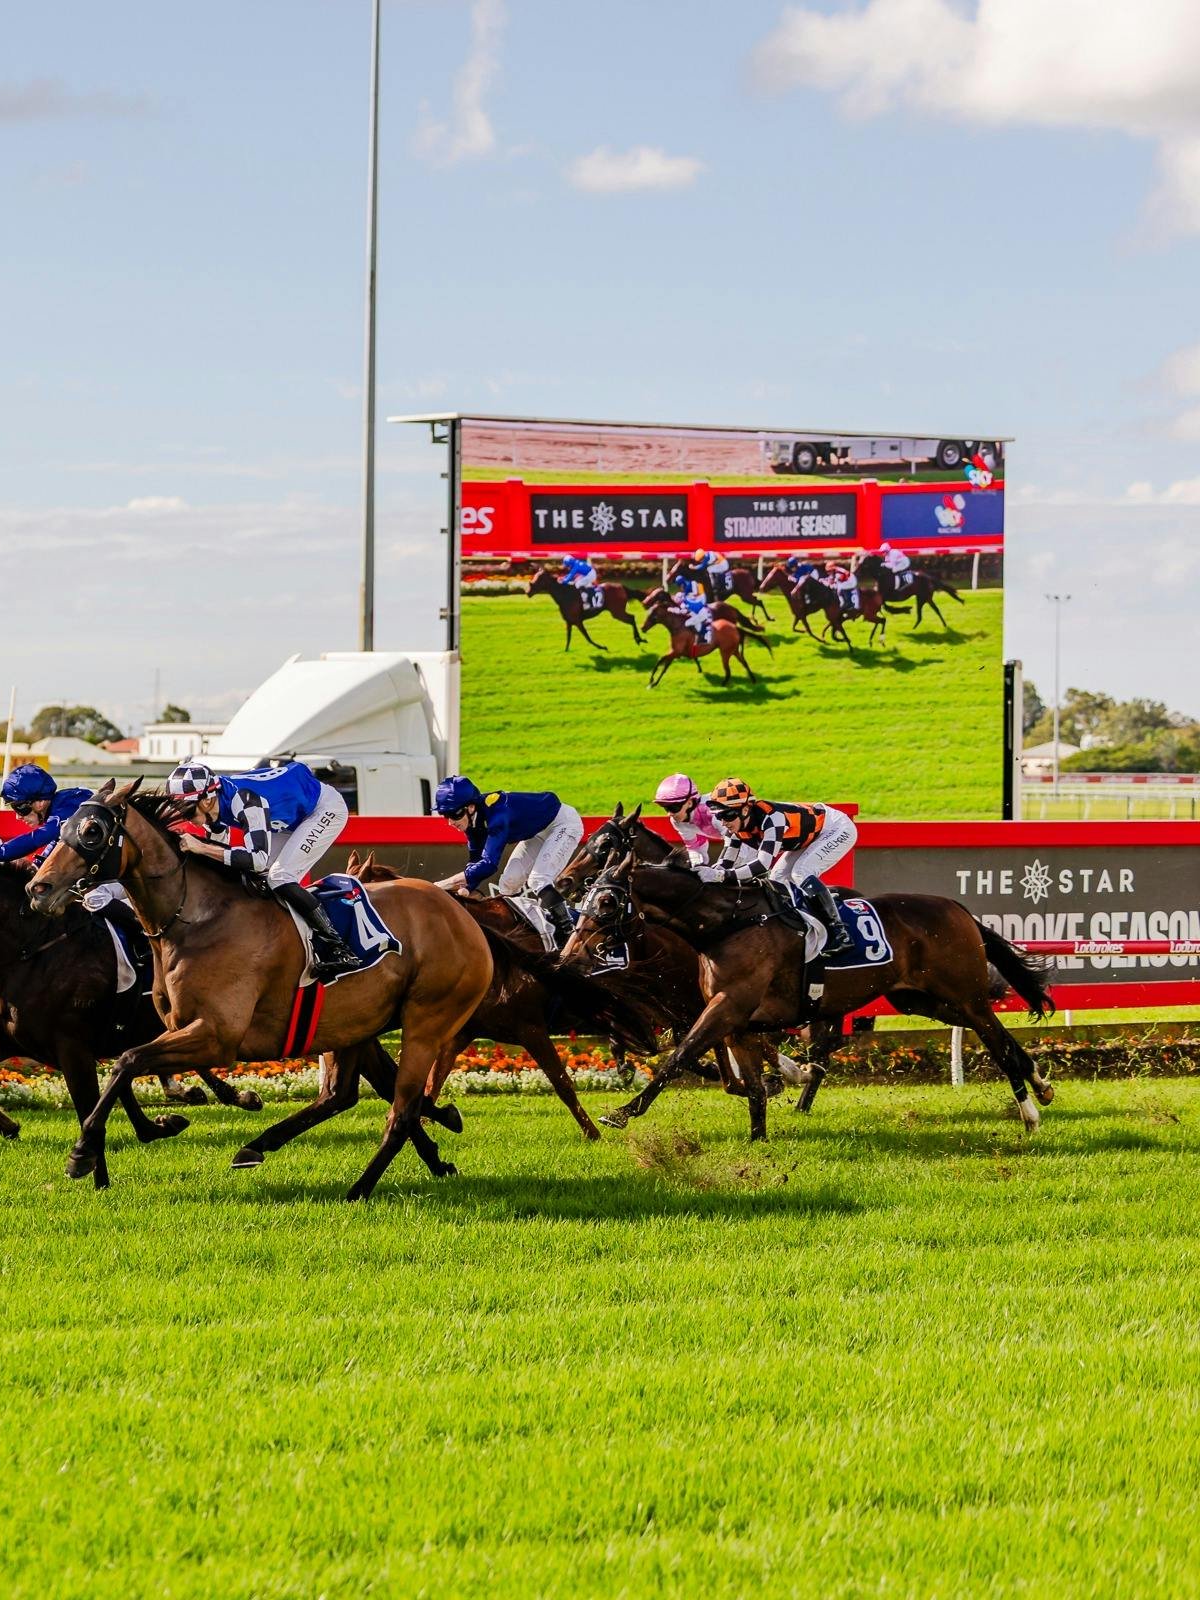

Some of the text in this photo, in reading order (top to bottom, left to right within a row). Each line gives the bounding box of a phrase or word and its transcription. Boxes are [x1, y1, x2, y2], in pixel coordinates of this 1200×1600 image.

[752, 500, 819, 511] THE STAR
[534, 508, 684, 529] THE STAR
[724, 514, 847, 538] STRADBROKE SEASON
[300, 810, 336, 855] BAYLISS
[955, 868, 1135, 895] THE STAR
[353, 900, 390, 952] 4
[856, 915, 887, 961] 9
[1074, 941, 1125, 954] Ladbrokes
